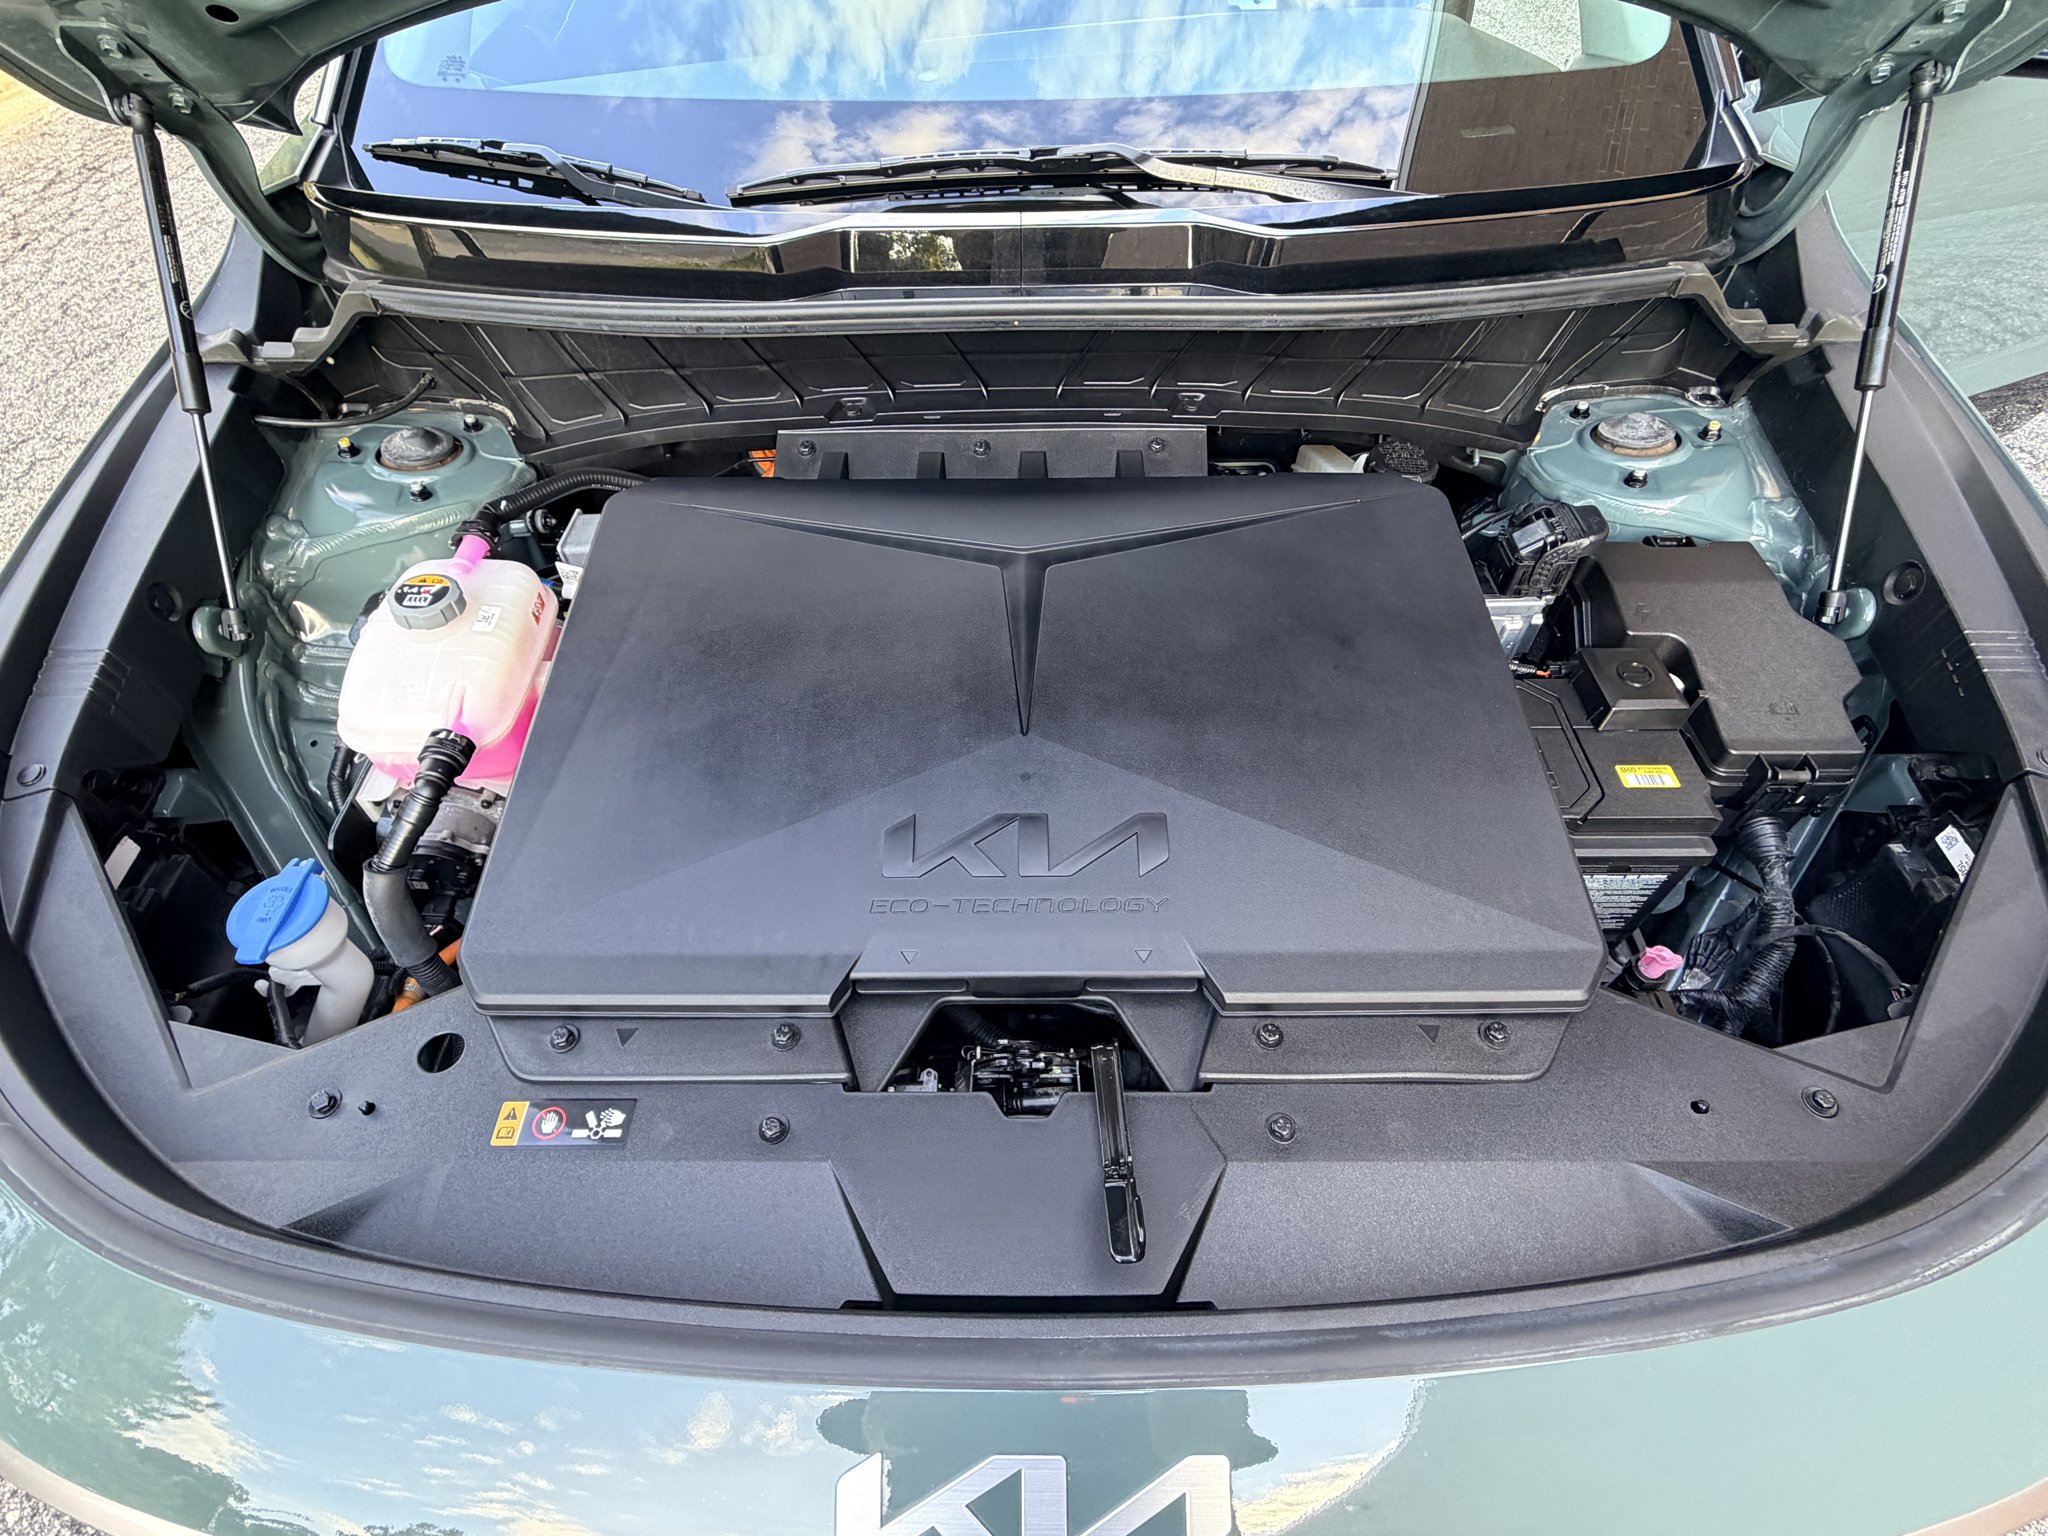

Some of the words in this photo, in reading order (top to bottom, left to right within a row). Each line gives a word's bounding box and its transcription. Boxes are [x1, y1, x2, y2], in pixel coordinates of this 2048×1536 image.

[881, 812, 1170, 878] KIA
[869, 898, 1169, 914] ECO-TECHNOLOGY
[836, 1452, 1232, 1536] KIA
